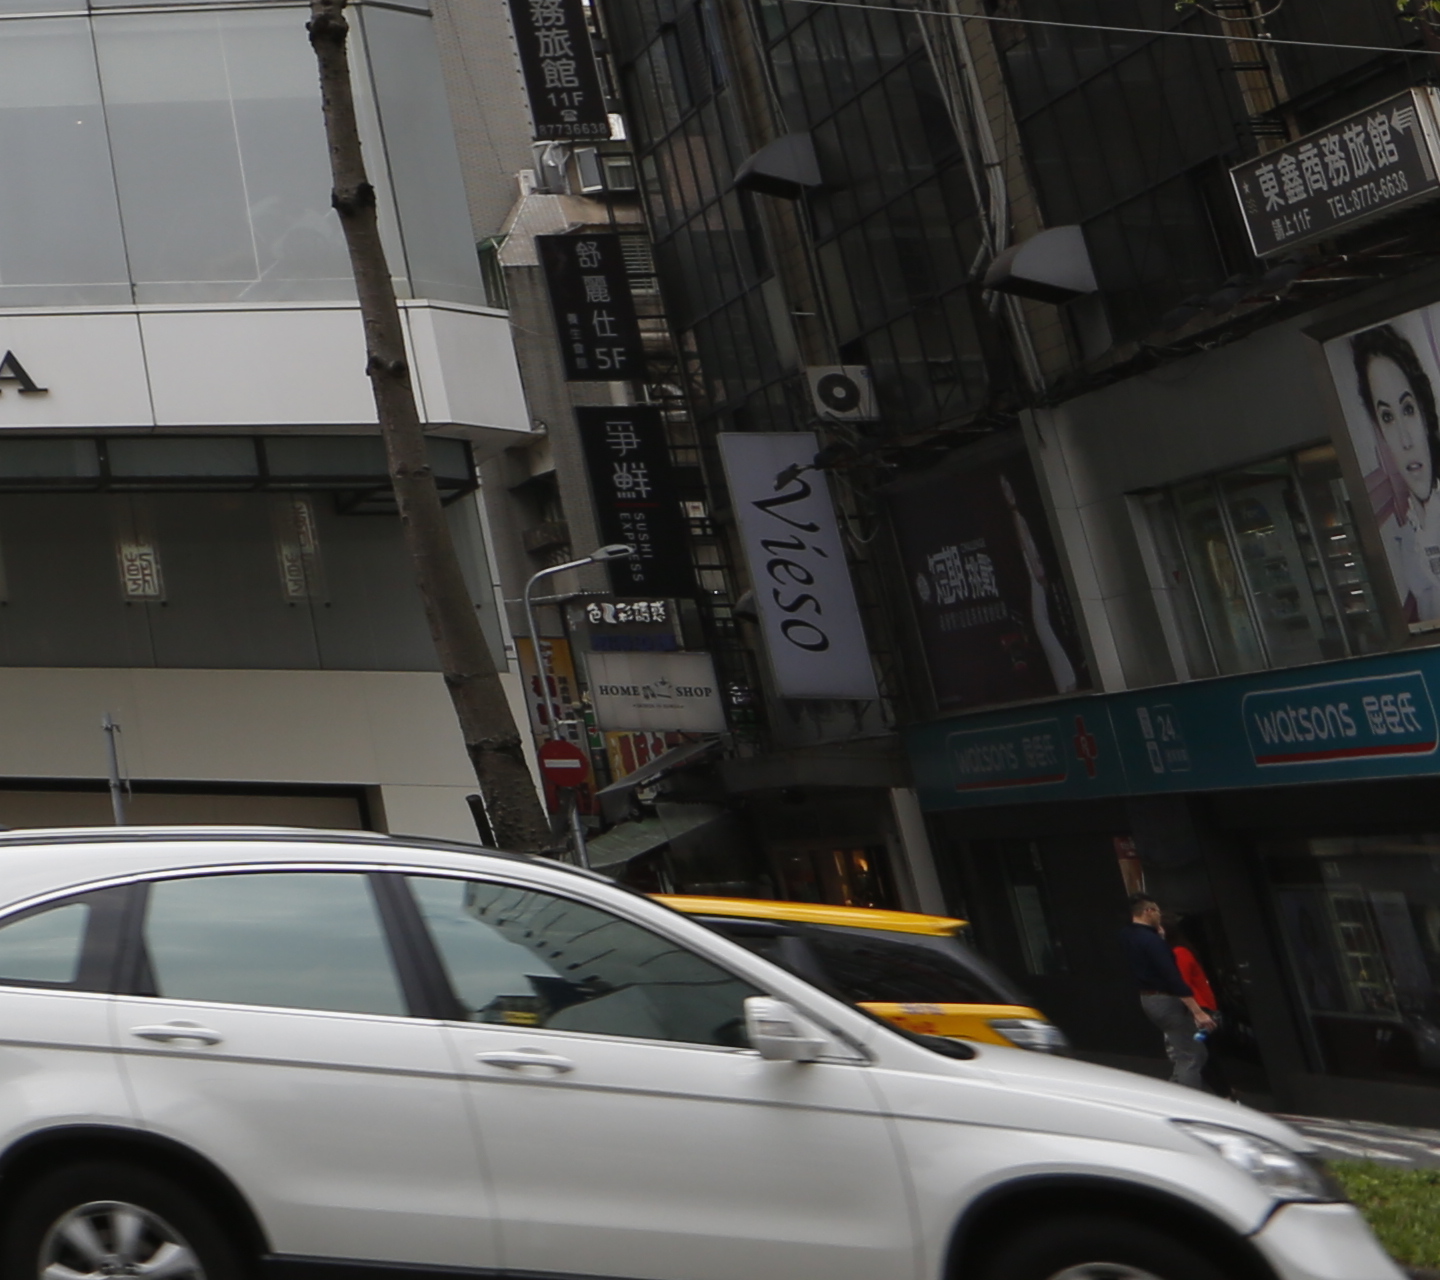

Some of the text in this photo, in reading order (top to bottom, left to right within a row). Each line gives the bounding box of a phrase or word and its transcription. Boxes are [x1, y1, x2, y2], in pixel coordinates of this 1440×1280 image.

[547, 92, 583, 108] 11F
[1254, 111, 1400, 212] 東鑫商務旅館
[1326, 170, 1409, 220] TEL:8773-6638
[594, 347, 626, 370] 5F
[605, 420, 653, 499] 爭鮮
[633, 512, 654, 559] SUSHI
[599, 684, 713, 698] HOME SHOP
[1255, 701, 1357, 745] watsons
[955, 741, 1017, 774] watsons
